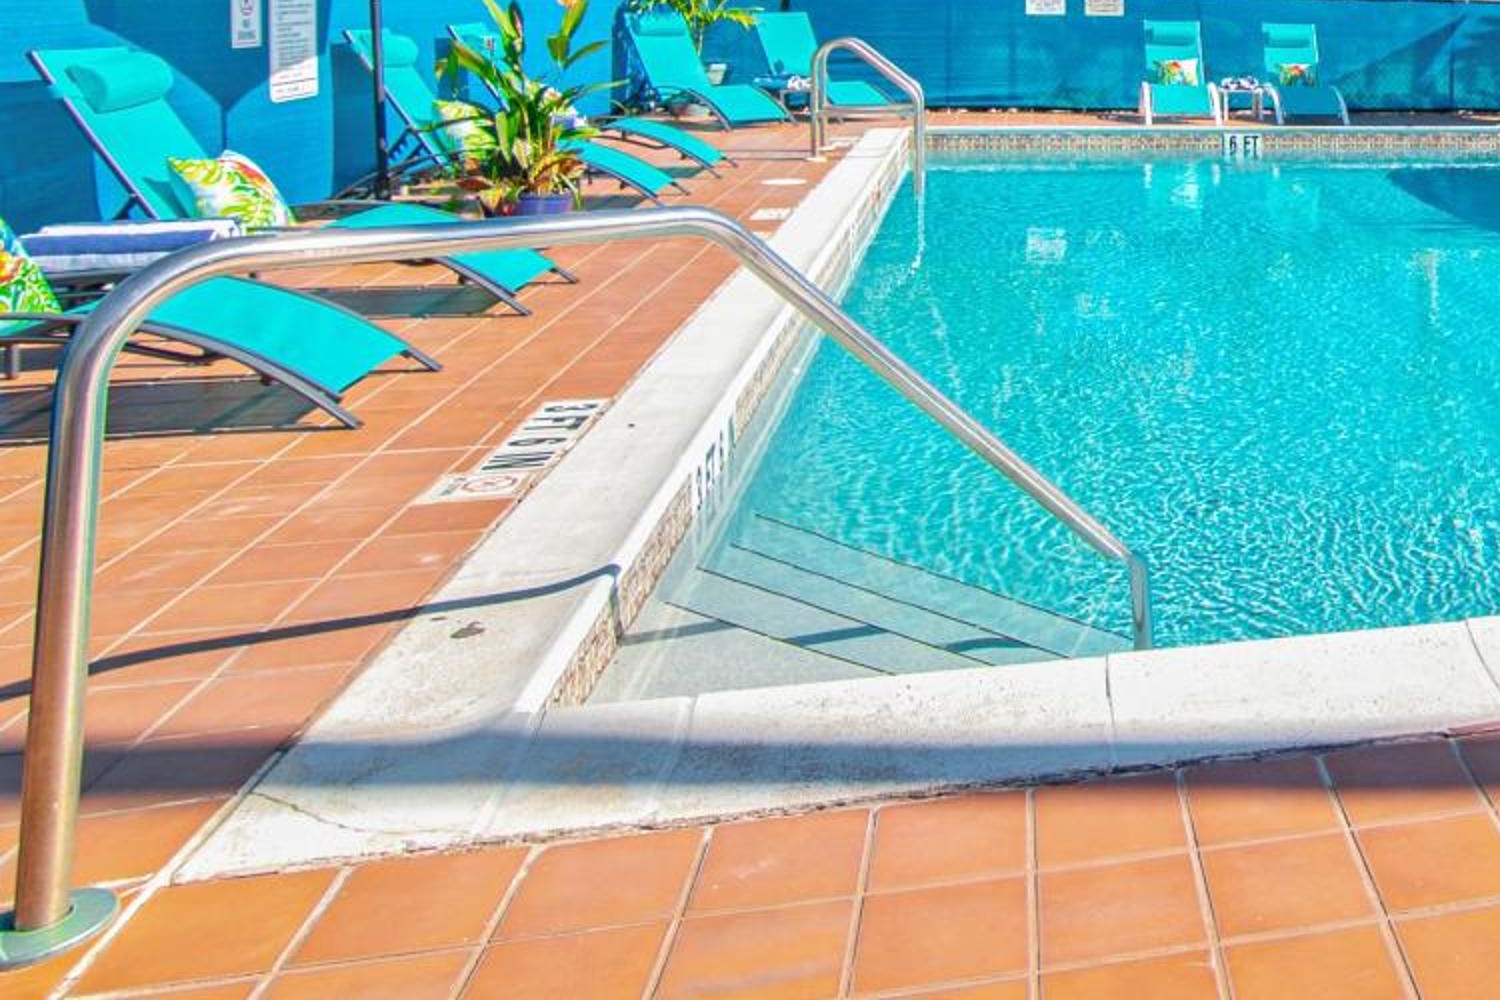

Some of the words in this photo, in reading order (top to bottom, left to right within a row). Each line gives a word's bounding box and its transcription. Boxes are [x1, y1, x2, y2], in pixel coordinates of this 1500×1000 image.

[1229, 135, 1237, 155] 6
[1243, 135, 1258, 157] FT
[544, 403, 600, 413] 3
[523, 415, 590, 431] FT
[507, 437, 568, 447] 6
[705, 442, 716, 495] FT
